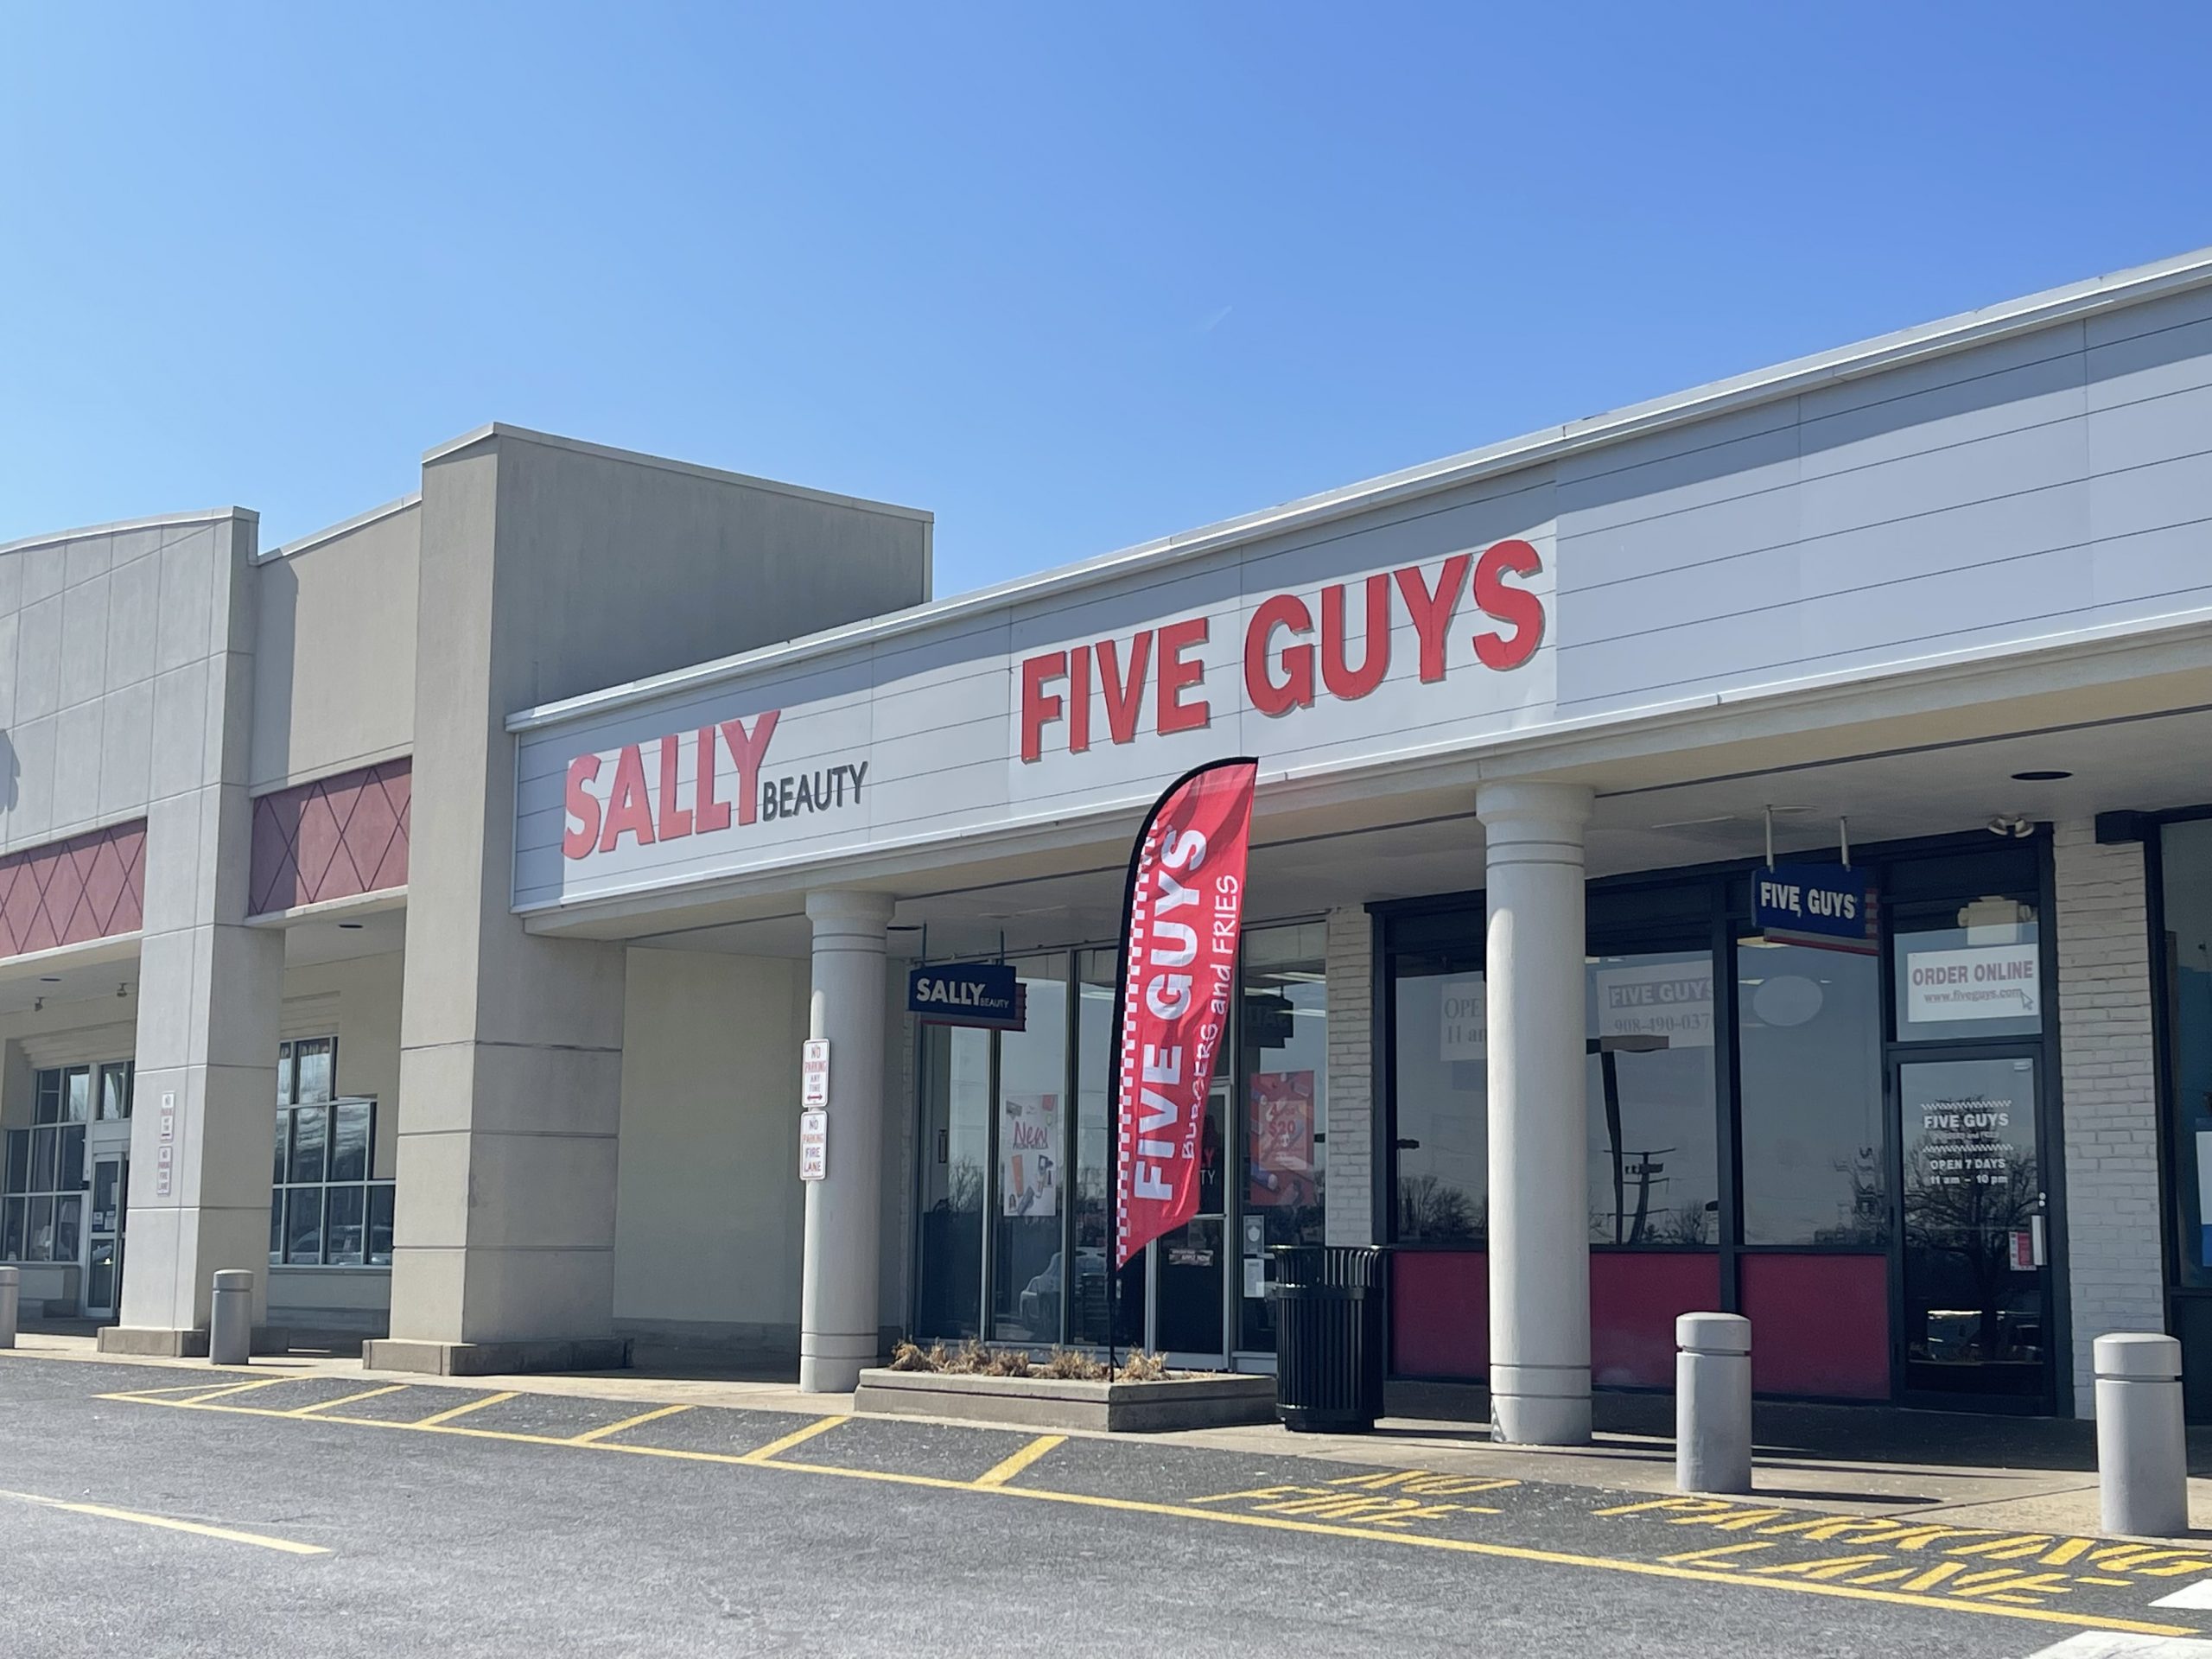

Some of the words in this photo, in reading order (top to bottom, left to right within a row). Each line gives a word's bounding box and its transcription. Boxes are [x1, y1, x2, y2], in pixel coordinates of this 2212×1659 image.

[1021, 616, 1210, 765] FIVE
[1244, 538, 1545, 718] GUYS
[562, 709, 781, 860] SALLY
[762, 761, 868, 822] BEAUTY
[1760, 881, 1800, 912] FIVE
[1808, 888, 1856, 919] GUYS
[1146, 830, 1207, 1020] GUYS
[1212, 874, 1238, 954] FRIES
[1912, 965, 1968, 986] ORDER
[1974, 960, 2033, 982] ONLINE
[916, 977, 986, 1006] SALLY
[1210, 963, 1232, 1014] and
[1611, 986, 1654, 1006] FIVE
[1923, 988, 2023, 1003] www.fiveguys.com
[980, 996, 1009, 1009] BEAUTY
[1444, 997, 1483, 1019] OPE
[811, 1046, 821, 1058] NO
[809, 1120, 819, 1129] NO
[1134, 1044, 1182, 1200] FIVE
[1923, 1114, 1960, 1128] FIVE
[1963, 1112, 2009, 1128] GUYS
[1014, 1121, 1047, 1146] New
[805, 1147, 820, 1158] FIRE
[1929, 1159, 1962, 1170] OPEN
[1965, 1159, 1972, 1169] 7
[1974, 1158, 2006, 1169] DAYS
[804, 1161, 821, 1172] LANE
[1929, 1175, 1941, 1185] 11
[1976, 1174, 1989, 1184] 10
[1325, 1468, 1522, 1496] NO
[1590, 1496, 2212, 1576] PARKING
[1186, 1484, 1503, 1527] FIRE
[1656, 1541, 2134, 1605] LANE
